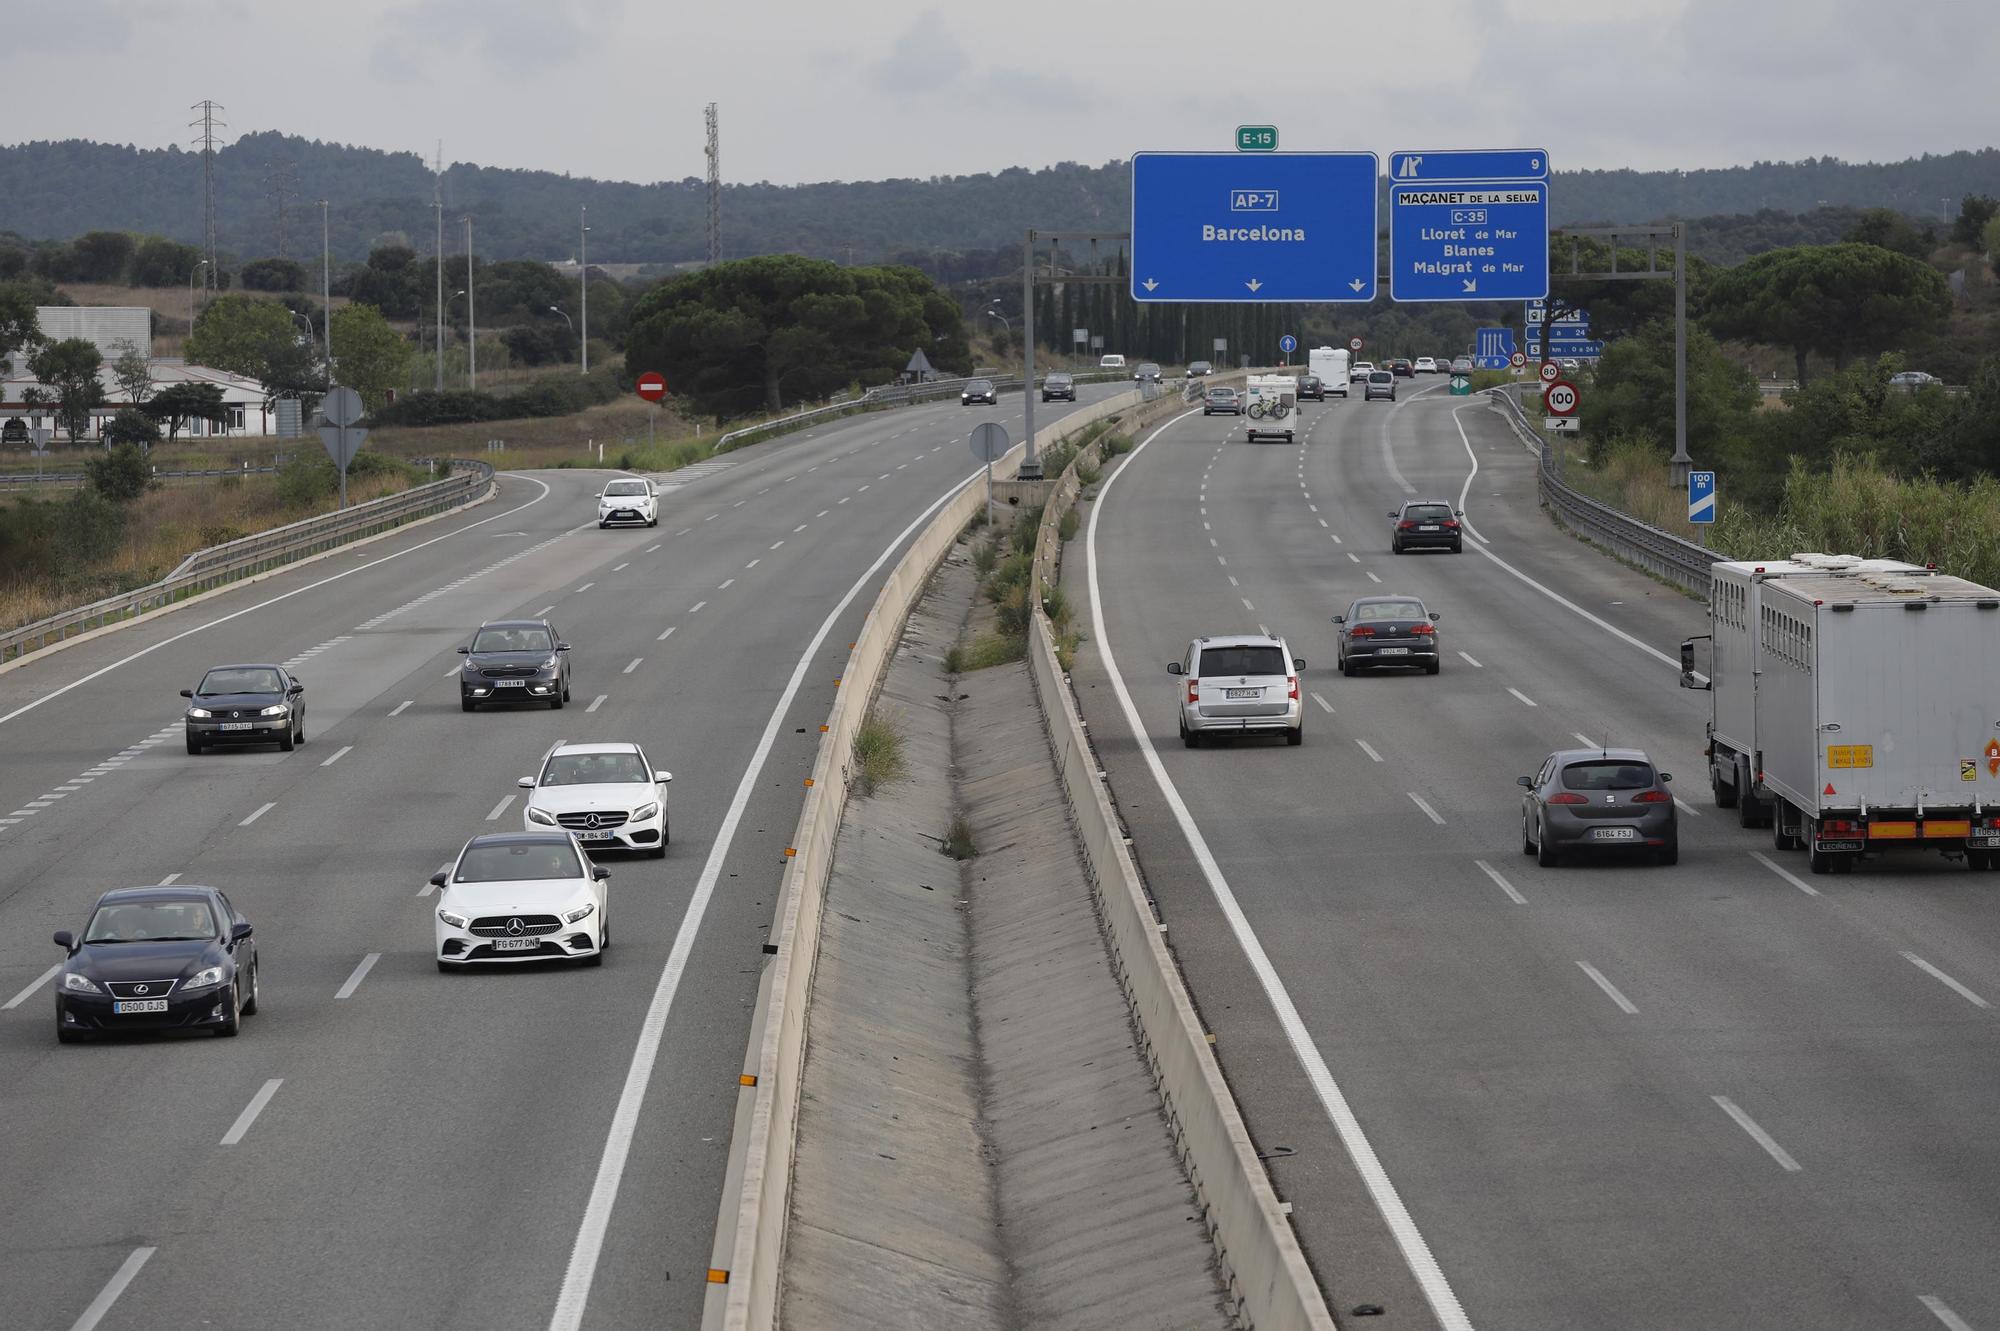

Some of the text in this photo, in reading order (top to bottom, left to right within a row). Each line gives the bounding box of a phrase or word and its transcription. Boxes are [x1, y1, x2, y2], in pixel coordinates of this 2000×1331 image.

[1242, 132, 1272, 144] E-15
[1531, 158, 1540, 170] 9
[1235, 194, 1275, 208] AP-7
[1400, 192, 1538, 205] MAÇANET DE LA SELVA
[1454, 211, 1485, 222] C-35
[1202, 224, 1305, 242] Barcelona
[1421, 227, 1518, 241] Lloret de Mar
[1444, 244, 1495, 257] Blanes
[1414, 261, 1525, 276] Malgrat de Mar
[1543, 368, 1556, 376] 80
[1551, 393, 1573, 404] 100
[121, 1001, 165, 1012] 0500 GJS
